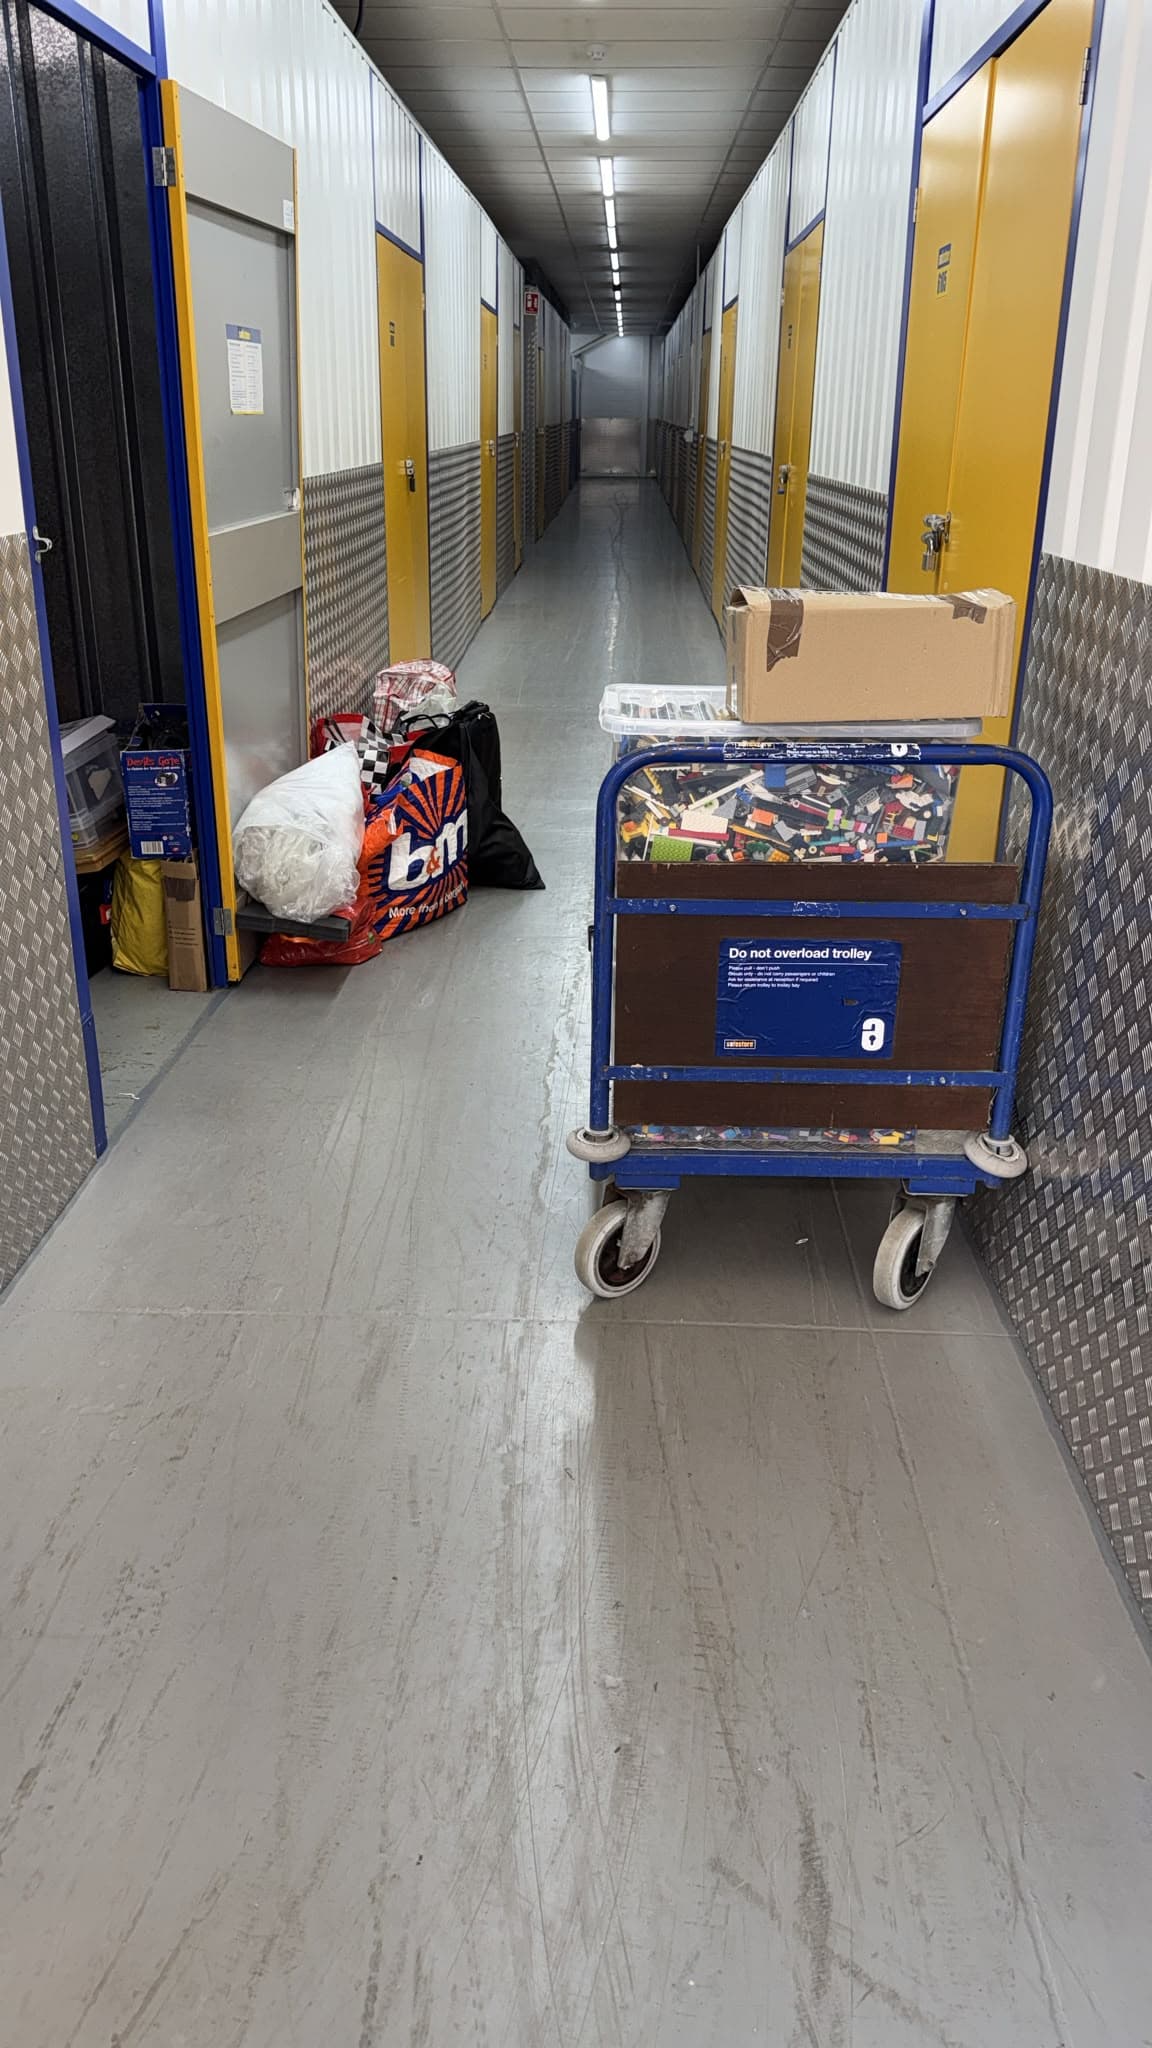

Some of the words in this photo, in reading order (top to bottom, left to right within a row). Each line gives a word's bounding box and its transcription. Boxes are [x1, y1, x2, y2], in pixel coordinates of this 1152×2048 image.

[158, 755, 181, 767] Gate
[388, 906, 416, 919] More
[418, 901, 438, 913] than
[729, 948, 747, 959] Do
[750, 948, 771, 959] not
[774, 948, 829, 959] overload
[832, 948, 872, 961] trolley
